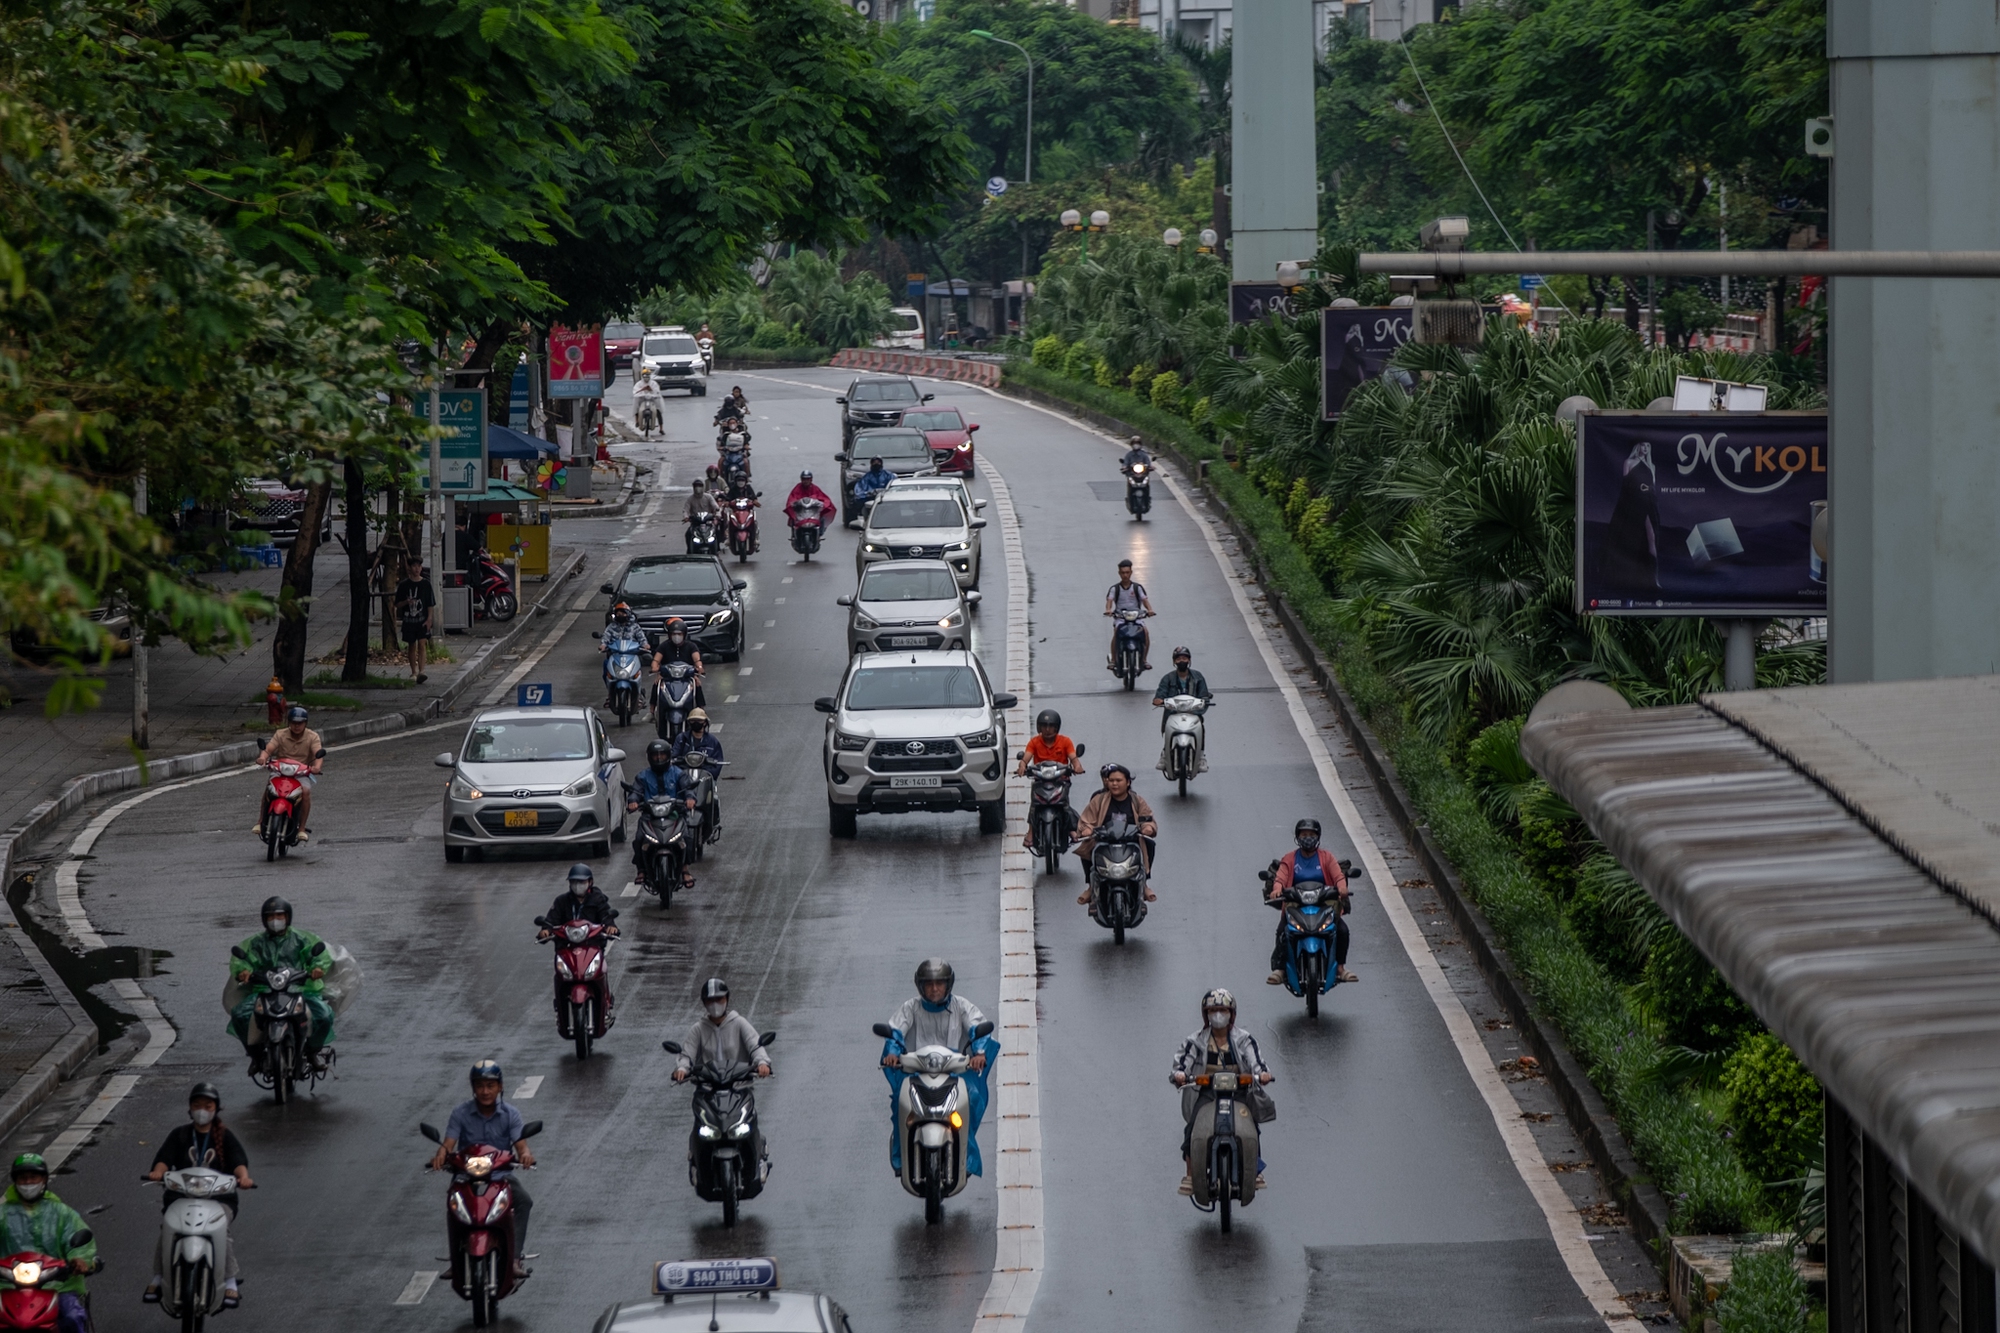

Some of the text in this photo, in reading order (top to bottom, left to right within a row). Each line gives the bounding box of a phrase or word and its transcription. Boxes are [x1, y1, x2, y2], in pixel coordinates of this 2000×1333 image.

[423, 402, 460, 416] BDV
[526, 685, 545, 704] G7
[693, 1266, 759, 1282] SAO THỦ ĐÔ
